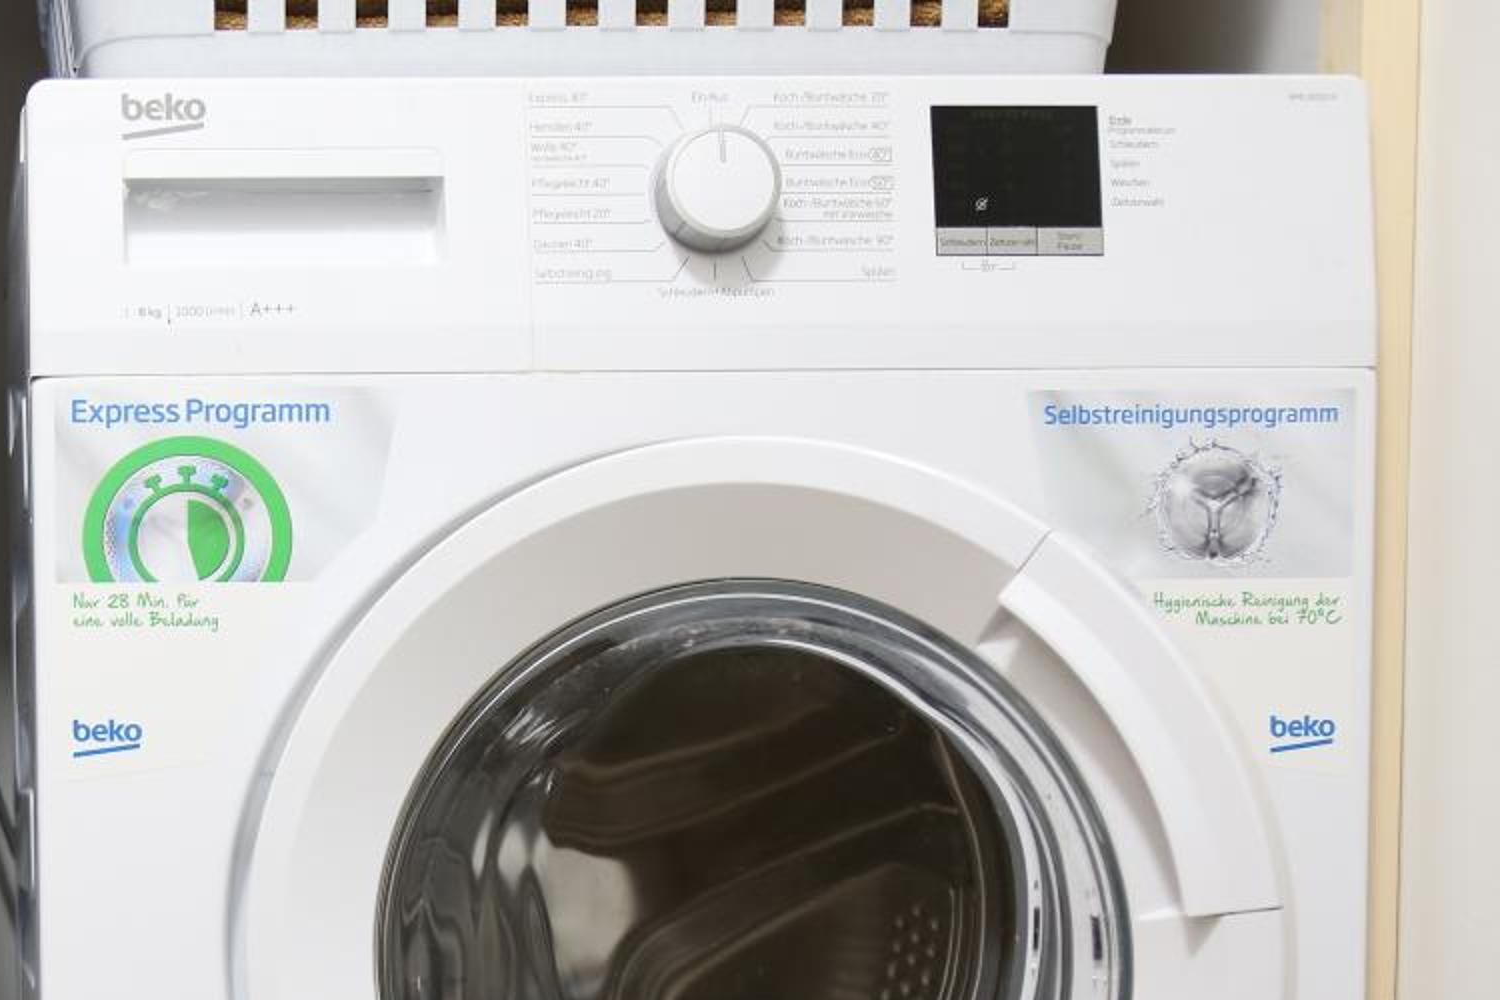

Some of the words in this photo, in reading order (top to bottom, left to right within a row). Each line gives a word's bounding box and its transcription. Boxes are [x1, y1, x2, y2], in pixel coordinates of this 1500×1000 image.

[121, 92, 207, 121] beko
[70, 399, 180, 428] Express
[186, 398, 331, 429] Programm
[1043, 404, 1339, 429] Selbstreinigungsprogramm
[1242, 591, 1308, 612] Reinigung
[1315, 591, 1340, 608] der
[111, 610, 143, 628] volle
[149, 610, 220, 632] Beladung
[72, 719, 143, 743] beko
[1269, 715, 1336, 738] beko
